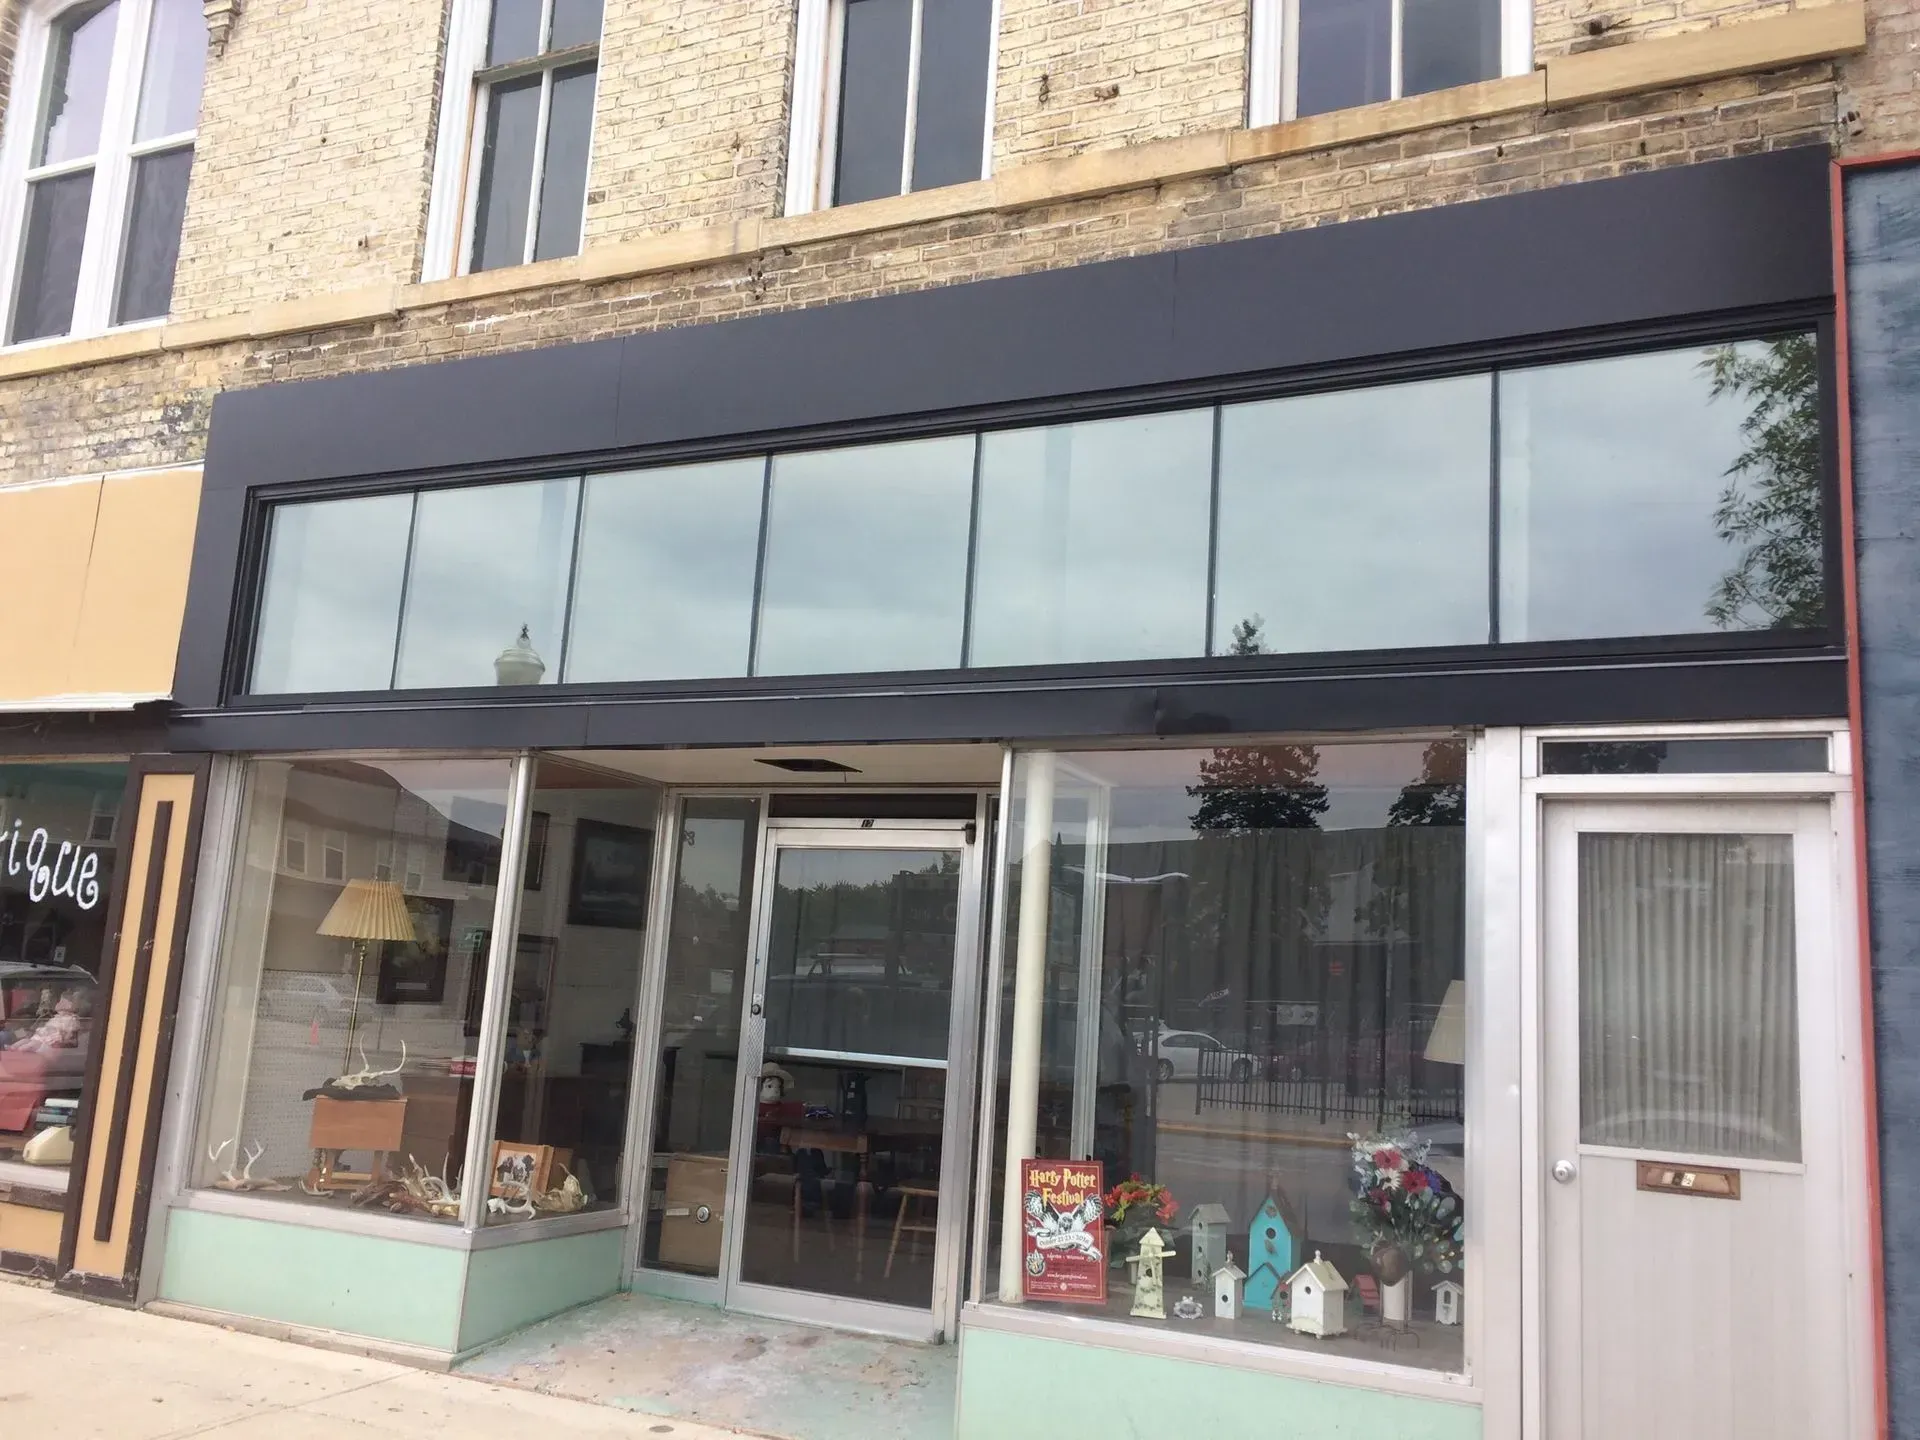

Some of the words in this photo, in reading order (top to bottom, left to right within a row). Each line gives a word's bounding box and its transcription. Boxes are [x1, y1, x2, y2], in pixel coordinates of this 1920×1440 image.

[0, 818, 99, 910] ique
[1029, 1169, 1062, 1187] Harry
[1063, 1168, 1096, 1190] Potter
[1042, 1187, 1084, 1207] Festival
